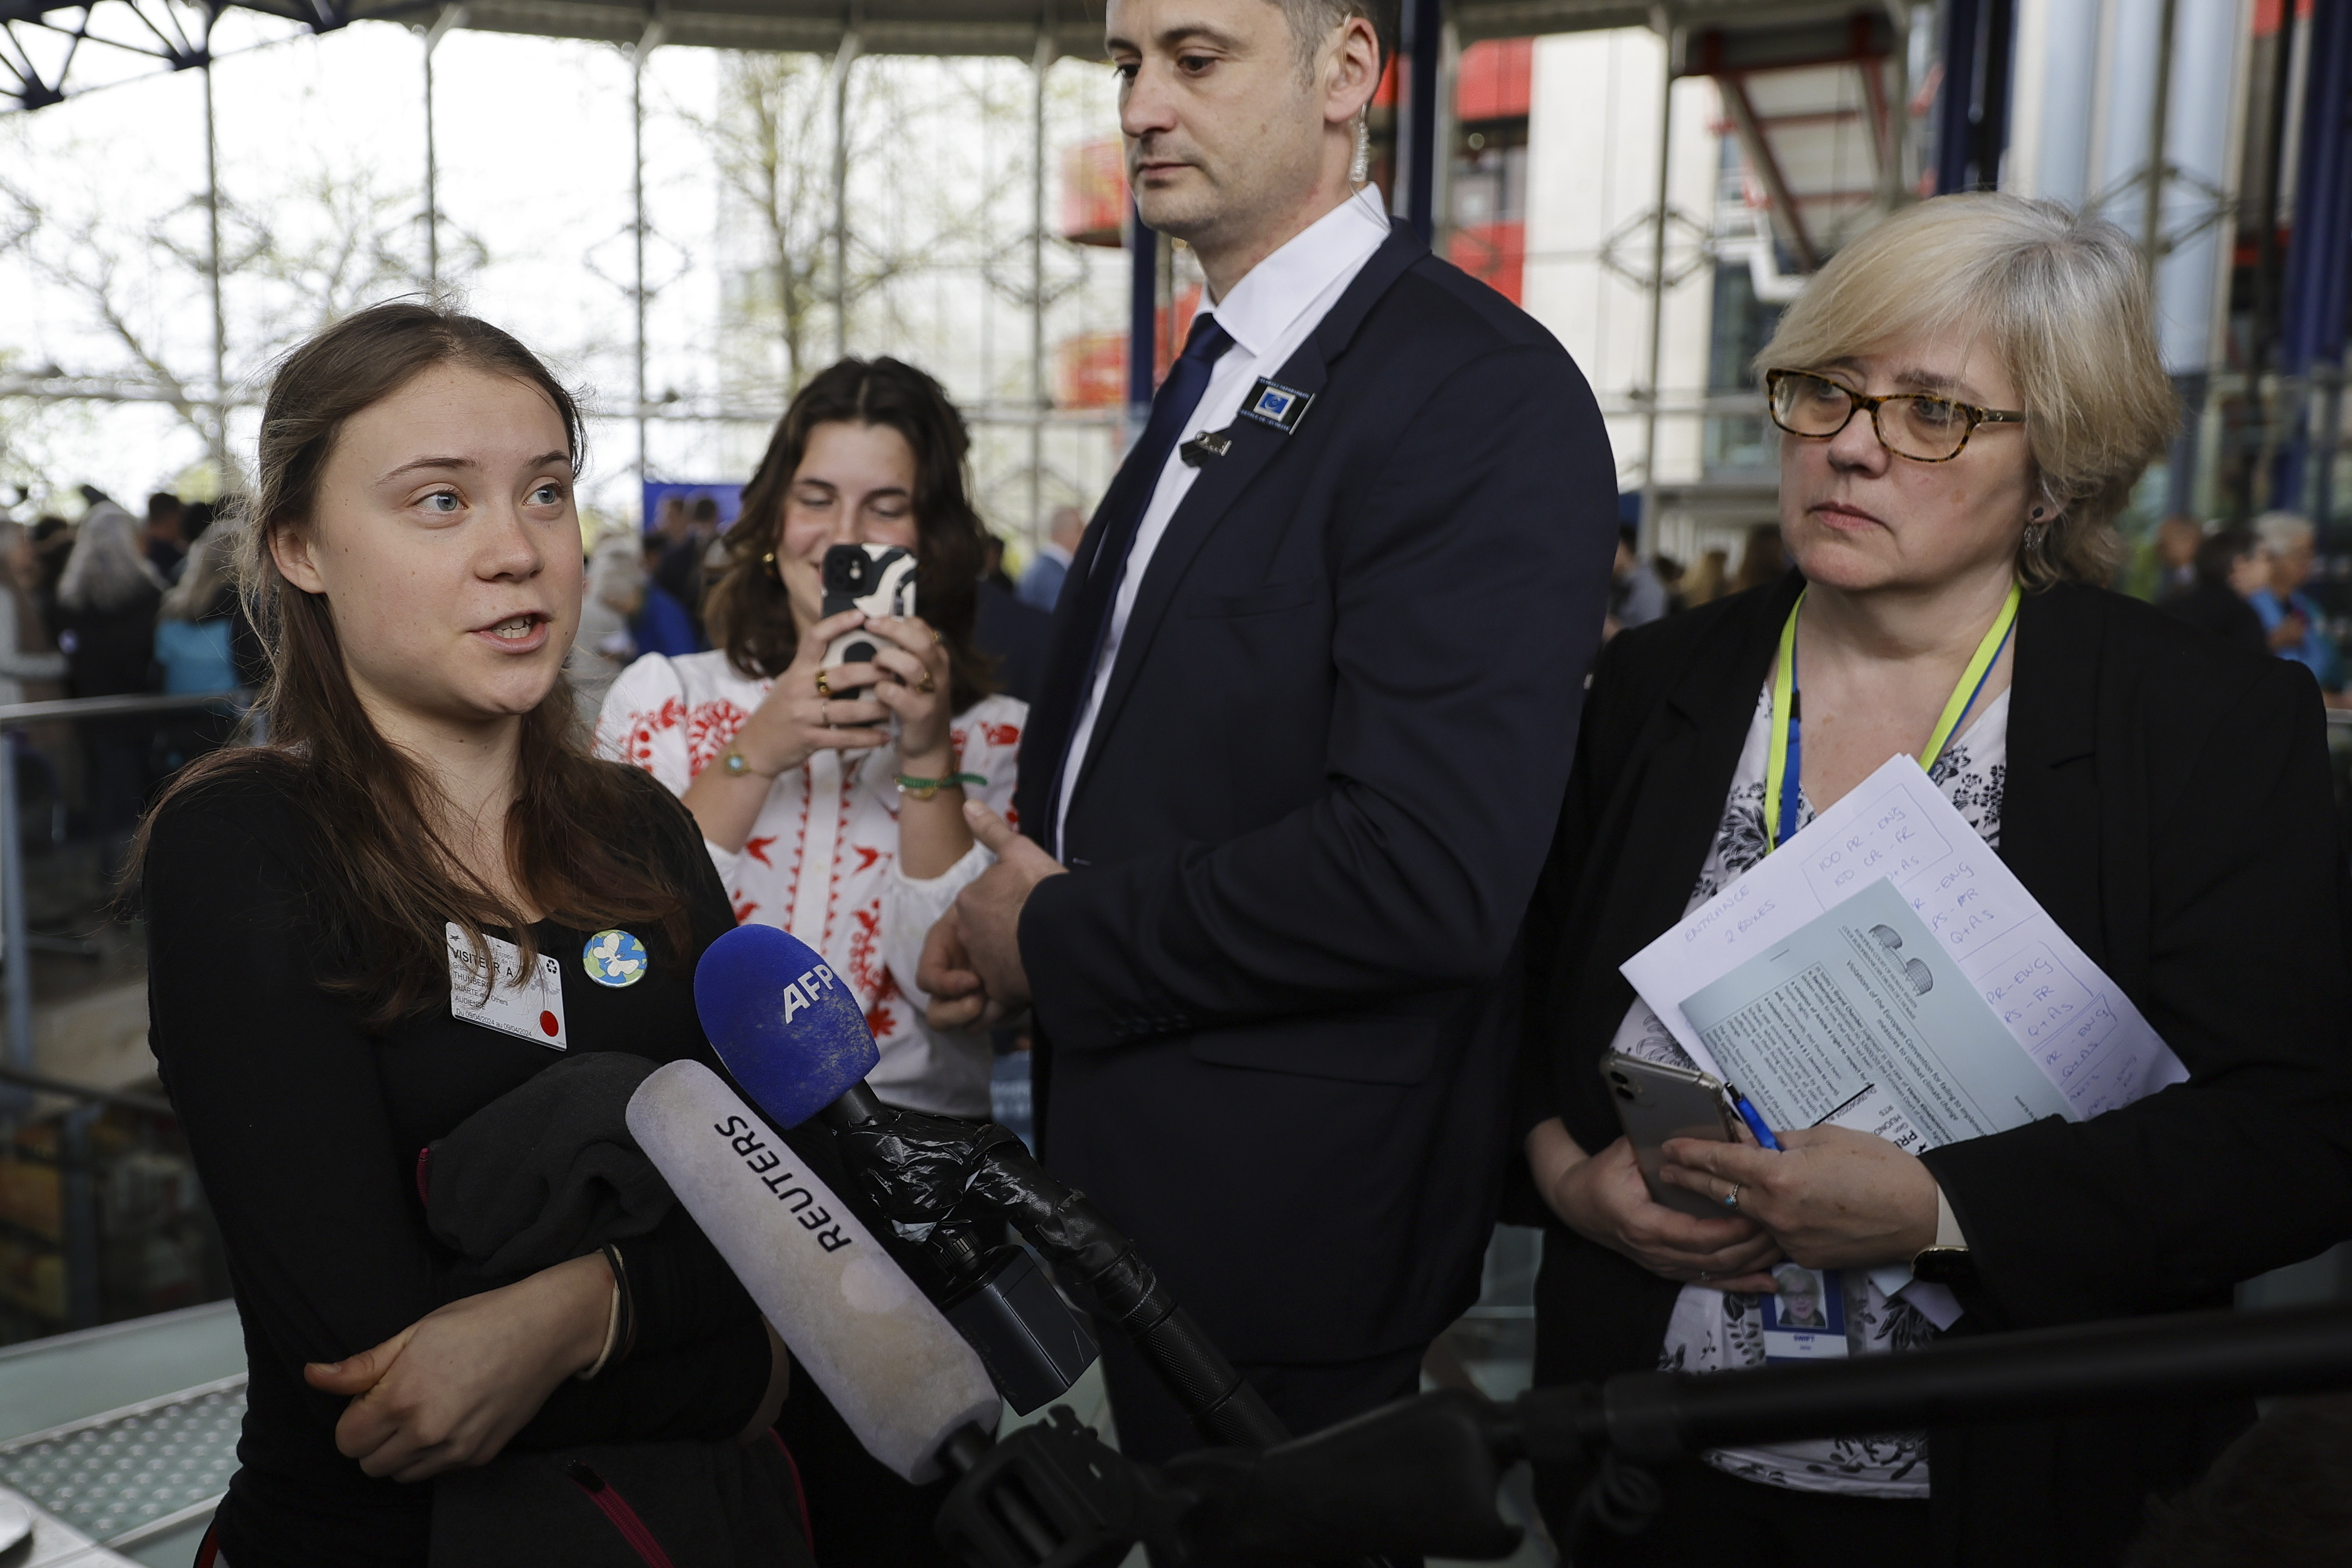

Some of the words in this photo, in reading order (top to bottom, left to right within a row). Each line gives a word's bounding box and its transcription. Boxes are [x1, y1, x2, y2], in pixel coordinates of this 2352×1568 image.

[1894, 825, 1916, 844] FR
[1817, 850, 1842, 872] 100
[1846, 835, 1863, 853] PR
[1684, 884, 1751, 943] ENTRANCE
[1909, 897, 1926, 910] R
[1722, 929, 1735, 944] 2
[451, 947, 501, 973] VISITER
[452, 961, 468, 971] Greta
[453, 983, 480, 997] DUARTE
[490, 995, 509, 1006] Others
[783, 963, 836, 1024] AFP
[2032, 985, 2055, 1002] FR
[465, 1010, 495, 1026] 09/04/2024
[503, 1023, 532, 1037] 09/04/2024
[1845, 959, 1872, 991] Violations
[1873, 996, 1887, 1010] the
[1881, 1007, 1909, 1040] European
[1904, 1037, 1936, 1074] Convention
[1938, 1080, 1957, 1102] failing
[1875, 1018, 1901, 1049] measures
[1903, 1054, 1926, 1080] combat
[1921, 1077, 1943, 1102] climate
[1938, 1099, 1959, 1123] change
[1884, 1073, 1905, 1098] European
[1902, 1095, 1916, 1111] Court
[714, 1115, 853, 1253] REUTERS
